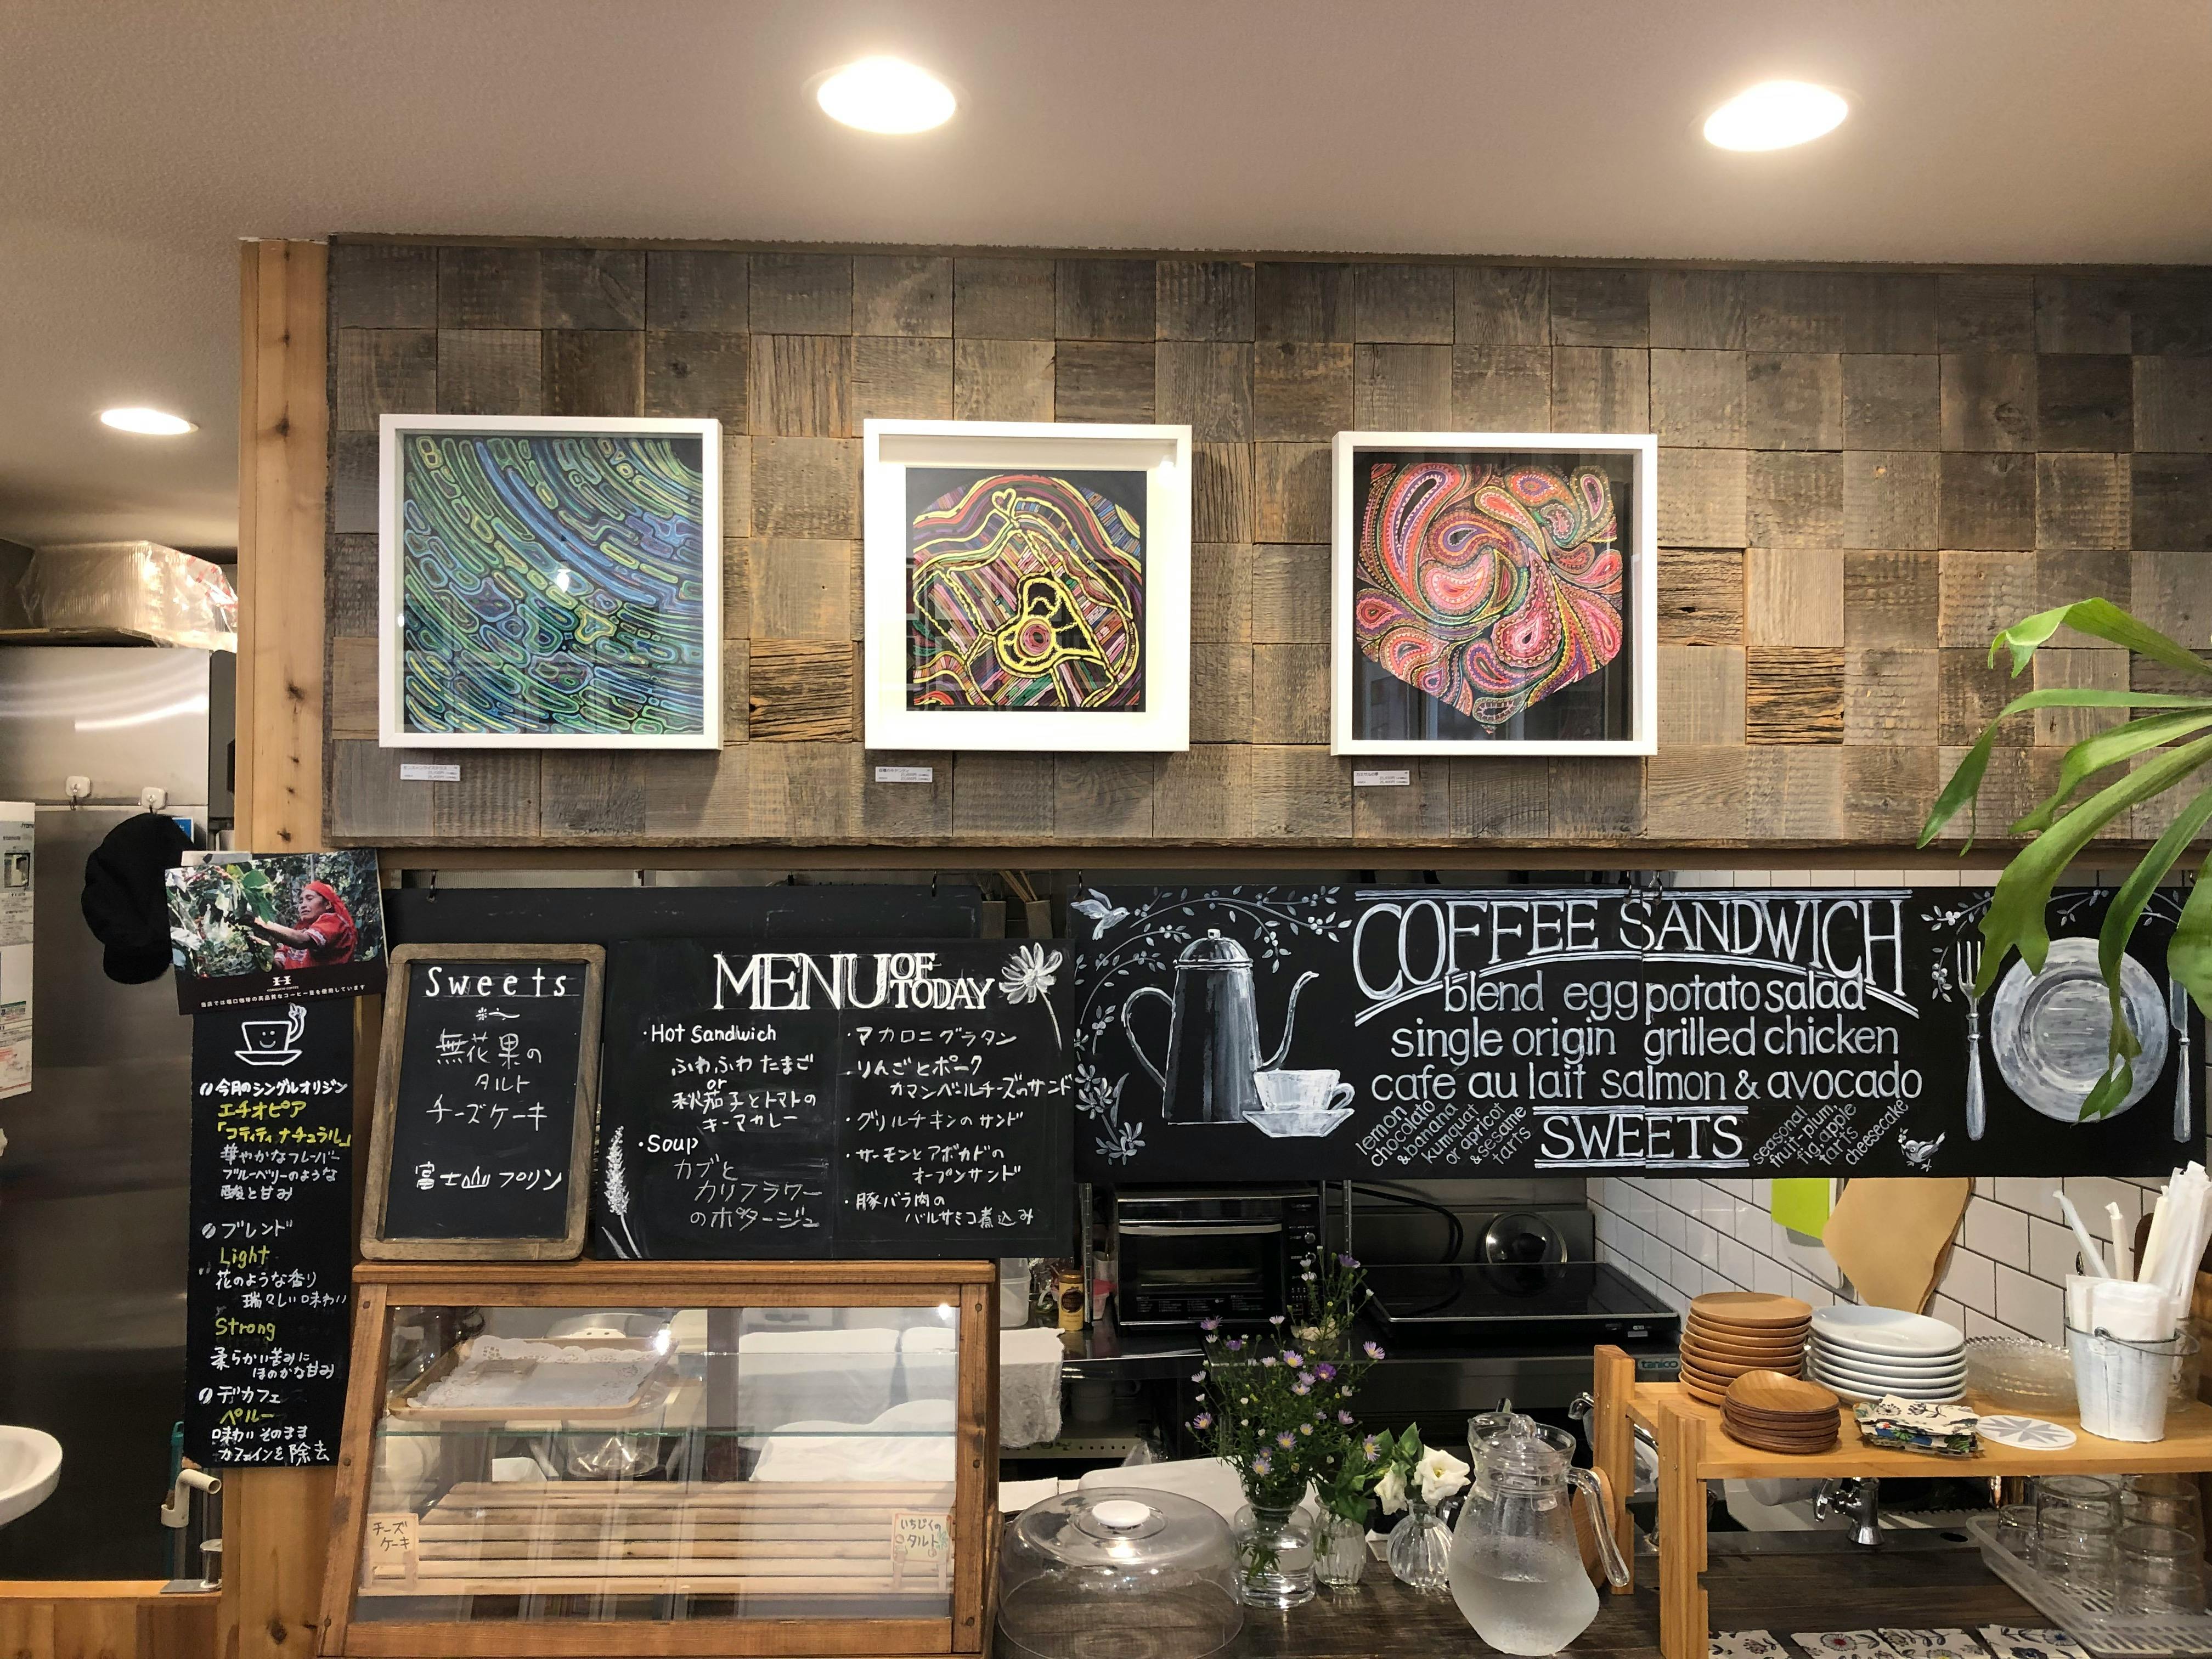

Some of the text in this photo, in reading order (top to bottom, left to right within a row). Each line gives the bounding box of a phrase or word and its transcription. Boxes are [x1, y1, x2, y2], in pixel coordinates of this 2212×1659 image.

[1353, 898, 1907, 1001] COFFEE SANDWICH
[425, 966, 567, 997] Sweets
[713, 952, 996, 1011] MENU OF TODAY
[1444, 969, 1866, 1025] blend egg potato salad
[651, 1023, 776, 1043] Hot Sandwich
[855, 1026, 1017, 1047] マカロニグラタン
[1391, 1013, 1899, 1066] single origin grilled chicken
[435, 1028, 541, 1070] 無花果の
[857, 1054, 982, 1079] りんごとポーク
[215, 1077, 348, 1097] 今月のシングルオリジン
[475, 1073, 530, 1094] タルト
[707, 1078, 727, 1090] or
[1372, 1060, 1922, 1101] cafe au lait salmon & avocado
[218, 1100, 307, 1120] エチオピア
[426, 1094, 548, 1131] チーズケーキ
[702, 1113, 798, 1132] キーマカレー
[1355, 1105, 1408, 1155] lemon
[1421, 1104, 1479, 1164] kumquat
[1446, 1102, 1505, 1165] or apricot
[1753, 1104, 1808, 1165] seasonal
[1846, 1099, 1909, 1165] cheesecake
[647, 1134, 698, 1155] Soup
[1492, 1126, 1531, 1165] tarts
[1541, 1114, 1743, 1159] SWEETS
[1819, 1126, 1859, 1165] tarts
[222, 1166, 338, 1184] ブルーベリーのような
[674, 1152, 738, 1181] カブと
[912, 1164, 1021, 1184] オープンサンド
[694, 1178, 822, 1204] カリフラワー
[856, 1191, 945, 1211] 豚バラ肉の
[222, 1219, 292, 1239] ブレンド
[221, 1245, 270, 1269] Light
[216, 1268, 317, 1290] 花のような香り
[216, 1317, 275, 1341] Strong
[1641, 1361, 1679, 1369] tanico
[217, 1386, 281, 1404] デカフェ
[219, 1408, 274, 1425] ペルー
[373, 1521, 408, 1536] チーズ
[901, 1518, 941, 1534] いちじくの
[380, 1537, 410, 1551] ケーキ
[907, 1534, 939, 1549] タルト
